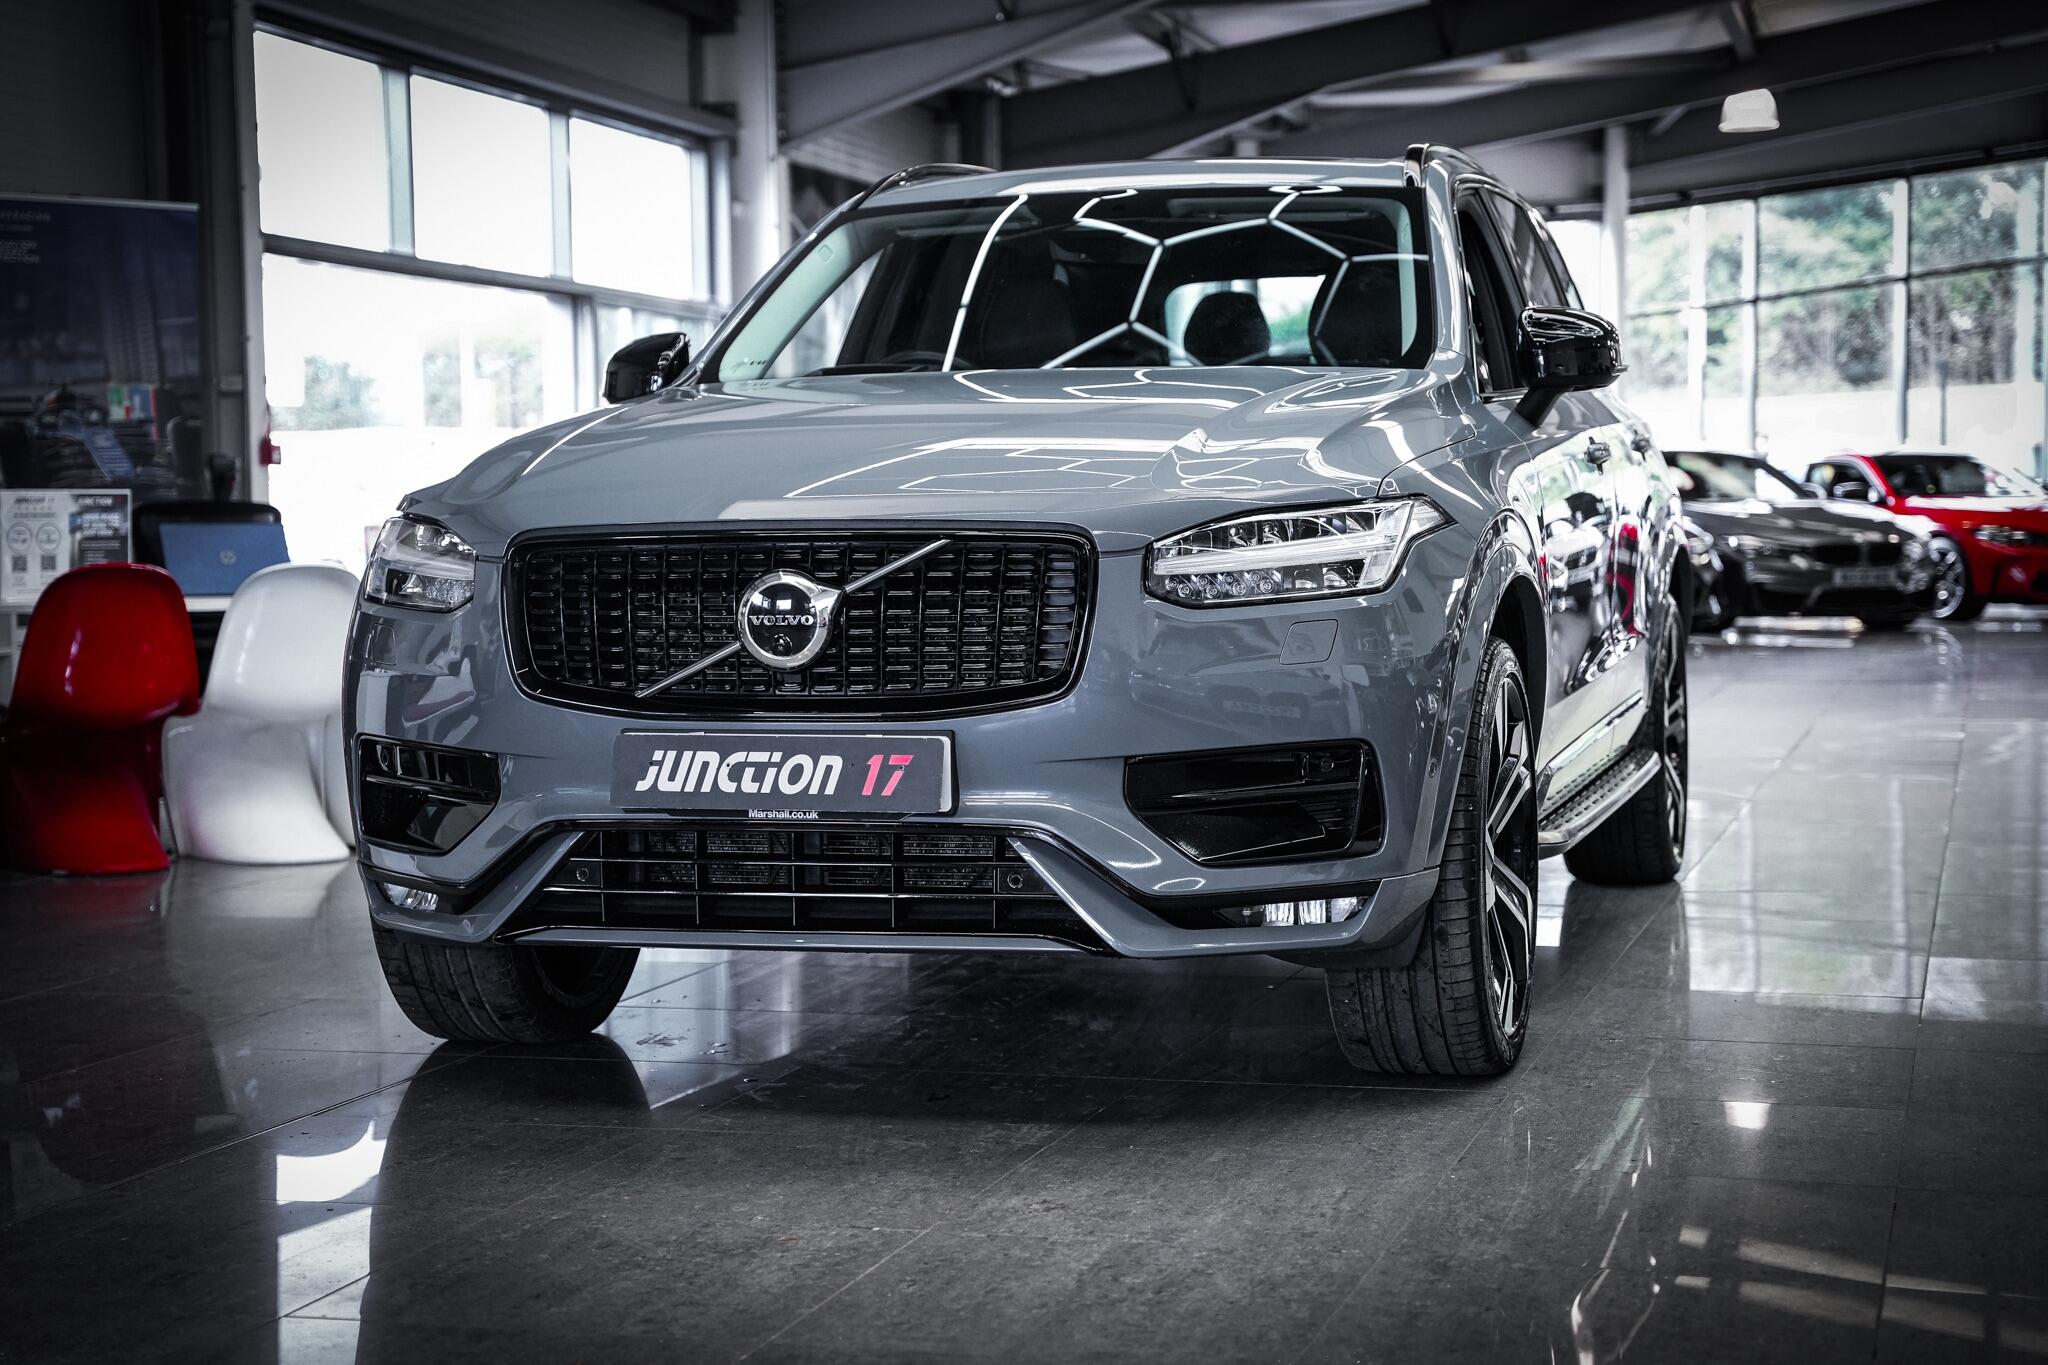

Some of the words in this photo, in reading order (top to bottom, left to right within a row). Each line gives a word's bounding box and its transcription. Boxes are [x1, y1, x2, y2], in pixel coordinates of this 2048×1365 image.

[749, 615, 814, 626] VOLVO
[862, 754, 914, 796] 17
[748, 809, 819, 819] Marshall.co.uk
